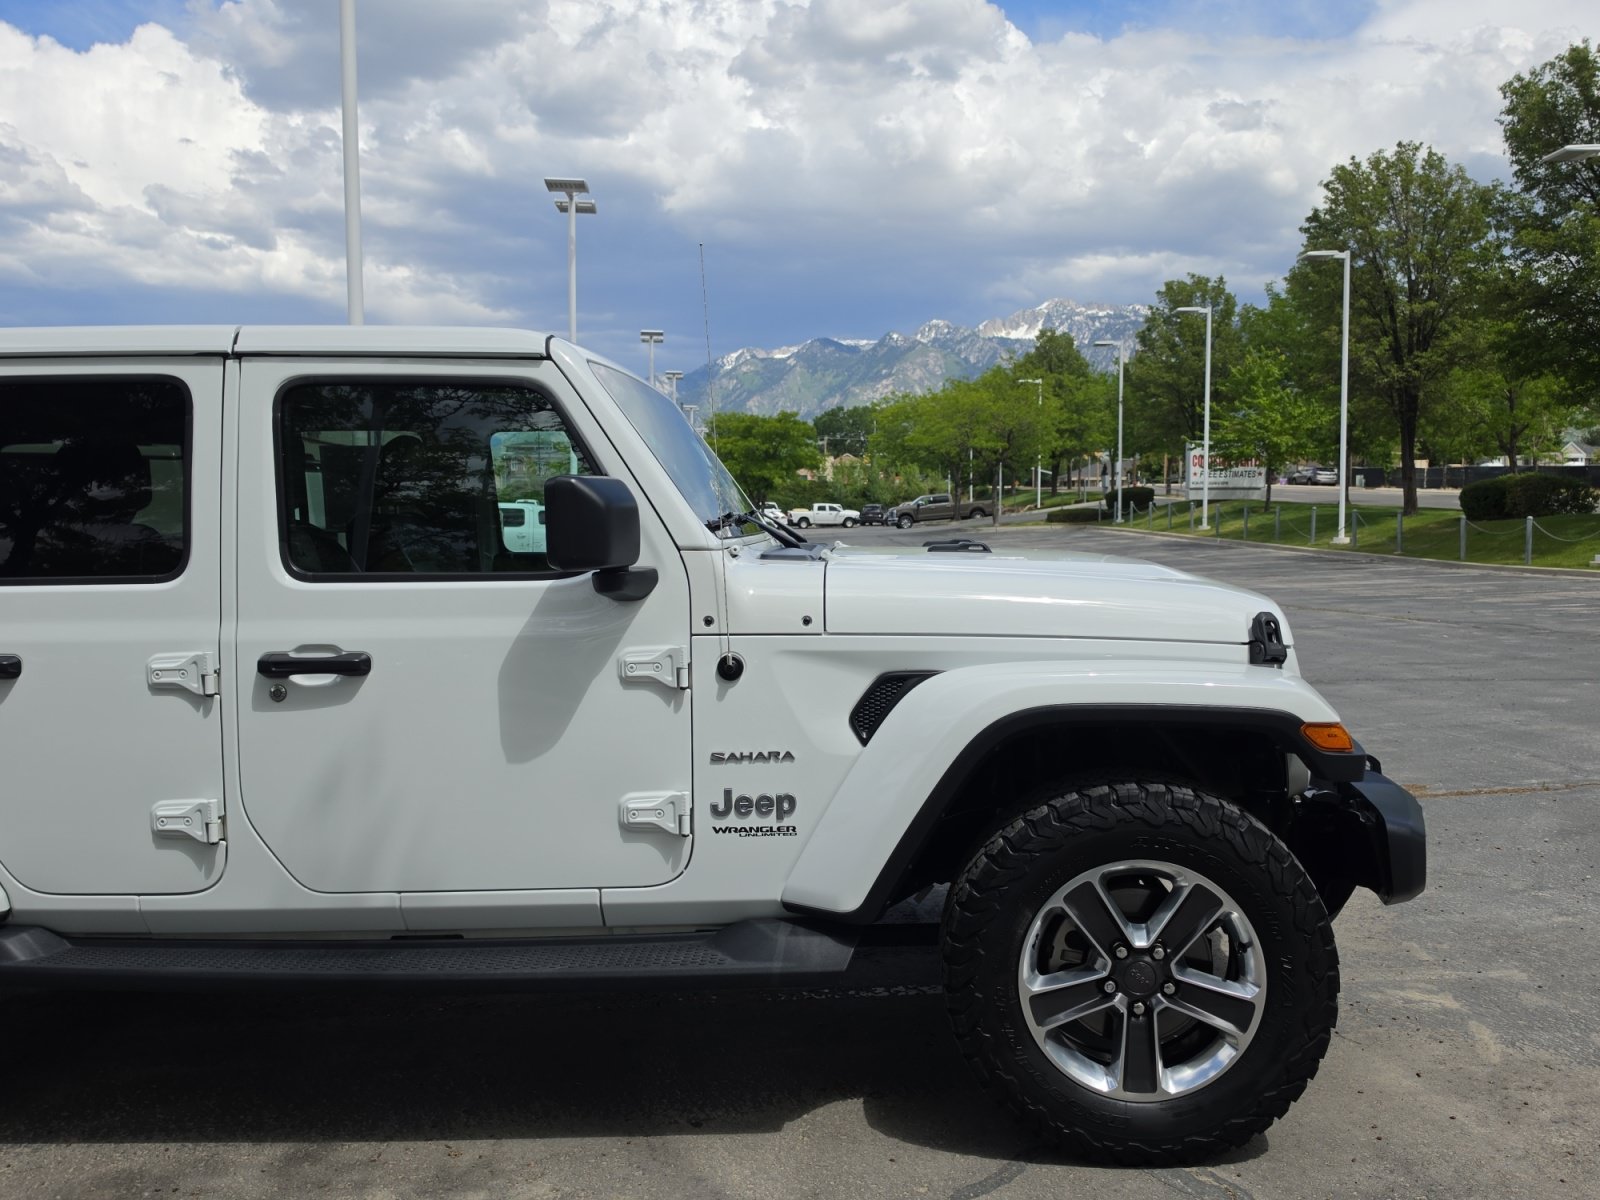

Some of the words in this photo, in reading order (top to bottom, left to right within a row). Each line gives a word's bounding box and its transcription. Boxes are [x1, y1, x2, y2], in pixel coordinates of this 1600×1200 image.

[1200, 470, 1217, 478] FEE
[1219, 470, 1257, 478] ESTIMATES
[709, 751, 795, 765] SAHARA
[709, 787, 797, 823] Jeep
[711, 825, 797, 834] WRANGLER
